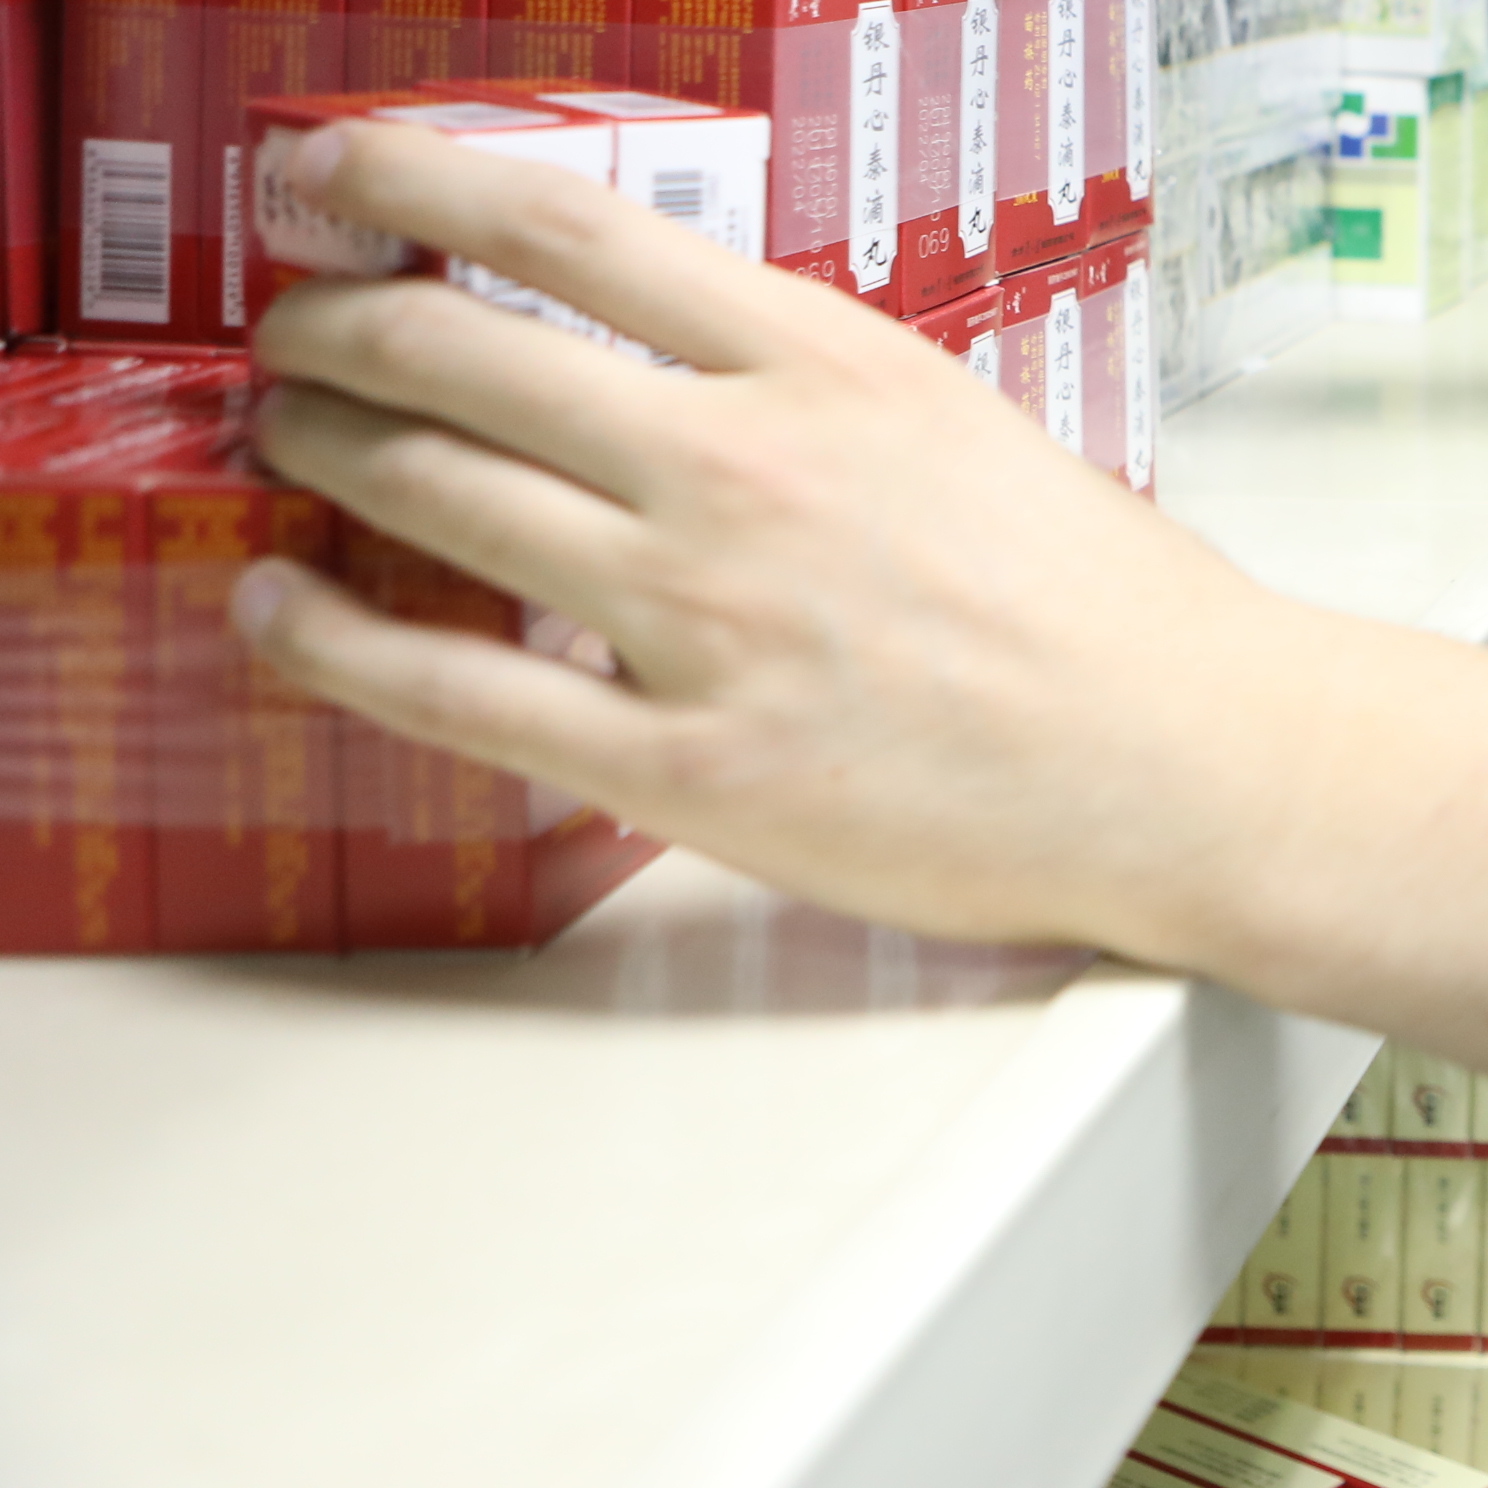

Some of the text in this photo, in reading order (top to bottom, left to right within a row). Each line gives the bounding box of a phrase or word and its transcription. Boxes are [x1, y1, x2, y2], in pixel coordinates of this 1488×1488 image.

[862, 21, 890, 270] 银丹心泰滴丸
[967, 6, 992, 237] 银丹心泰滴丸
[917, 227, 950, 260] 069
